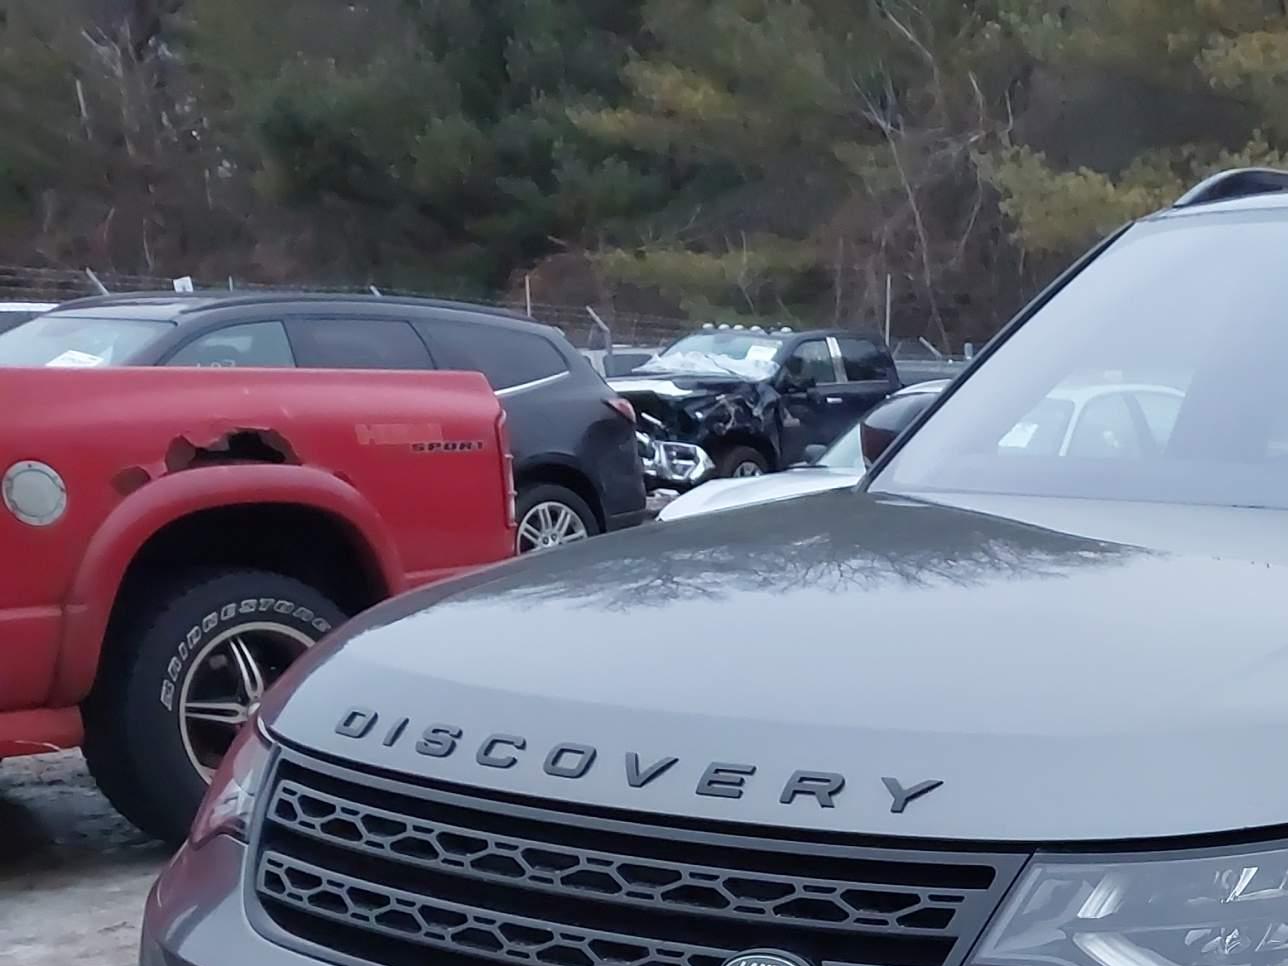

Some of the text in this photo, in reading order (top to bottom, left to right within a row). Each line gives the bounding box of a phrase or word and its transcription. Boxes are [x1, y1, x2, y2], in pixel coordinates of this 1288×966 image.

[411, 441, 483, 452] SPORT
[160, 598, 332, 711] BRIDGESTONE
[335, 707, 944, 813] DISCOVERY
